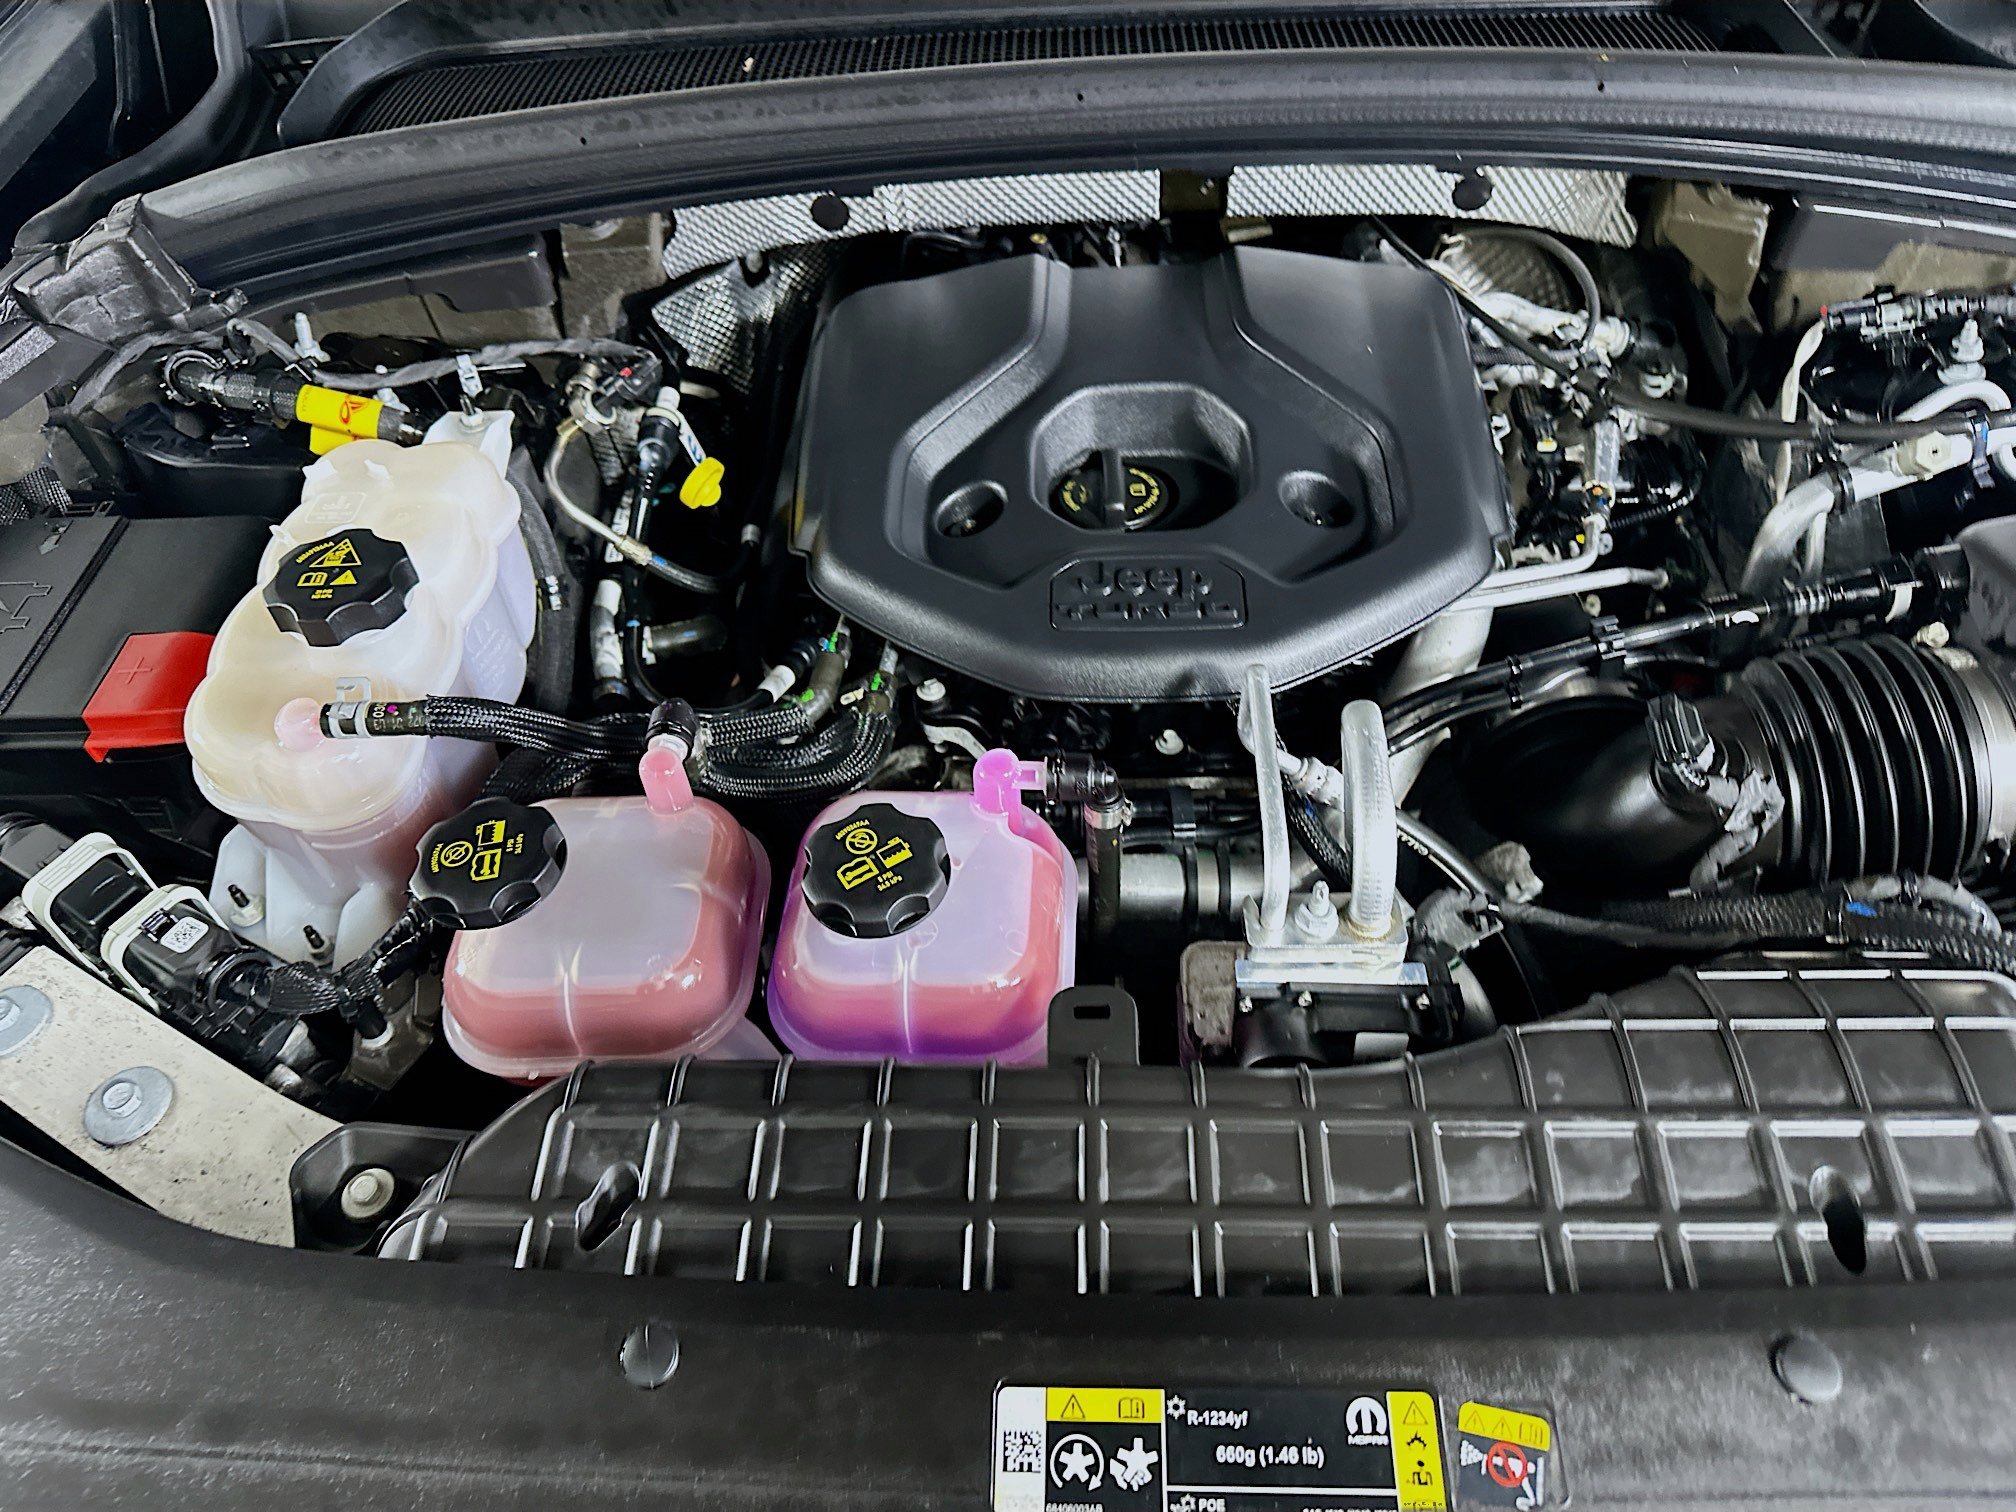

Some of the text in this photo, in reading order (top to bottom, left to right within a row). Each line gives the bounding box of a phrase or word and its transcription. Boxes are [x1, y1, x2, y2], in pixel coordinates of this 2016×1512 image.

[1077, 560, 1213, 602] Jeep
[1187, 1409, 1249, 1429] R-1234yf
[1302, 1445, 1325, 1469] lb)
[1198, 1498, 1227, 1512] POE
